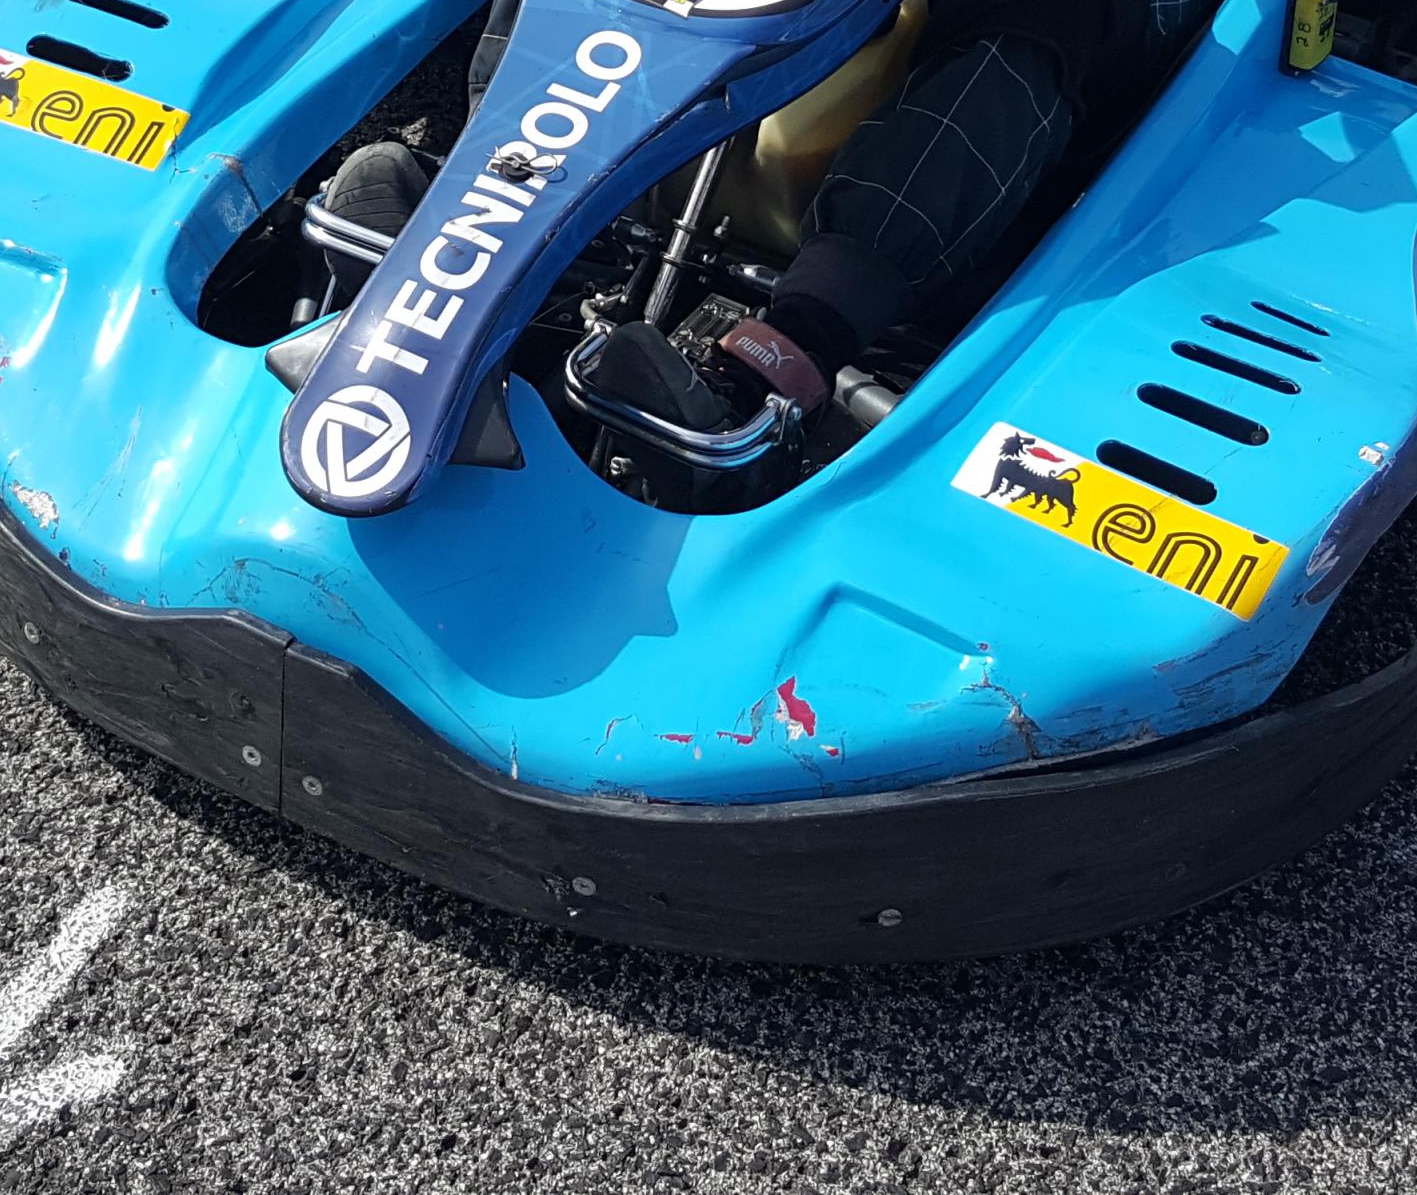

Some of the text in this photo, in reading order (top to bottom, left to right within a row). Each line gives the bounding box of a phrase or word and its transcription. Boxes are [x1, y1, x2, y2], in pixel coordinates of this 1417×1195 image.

[31, 90, 176, 165] eni
[736, 336, 776, 367] PUMA
[1091, 503, 1271, 611] eni
